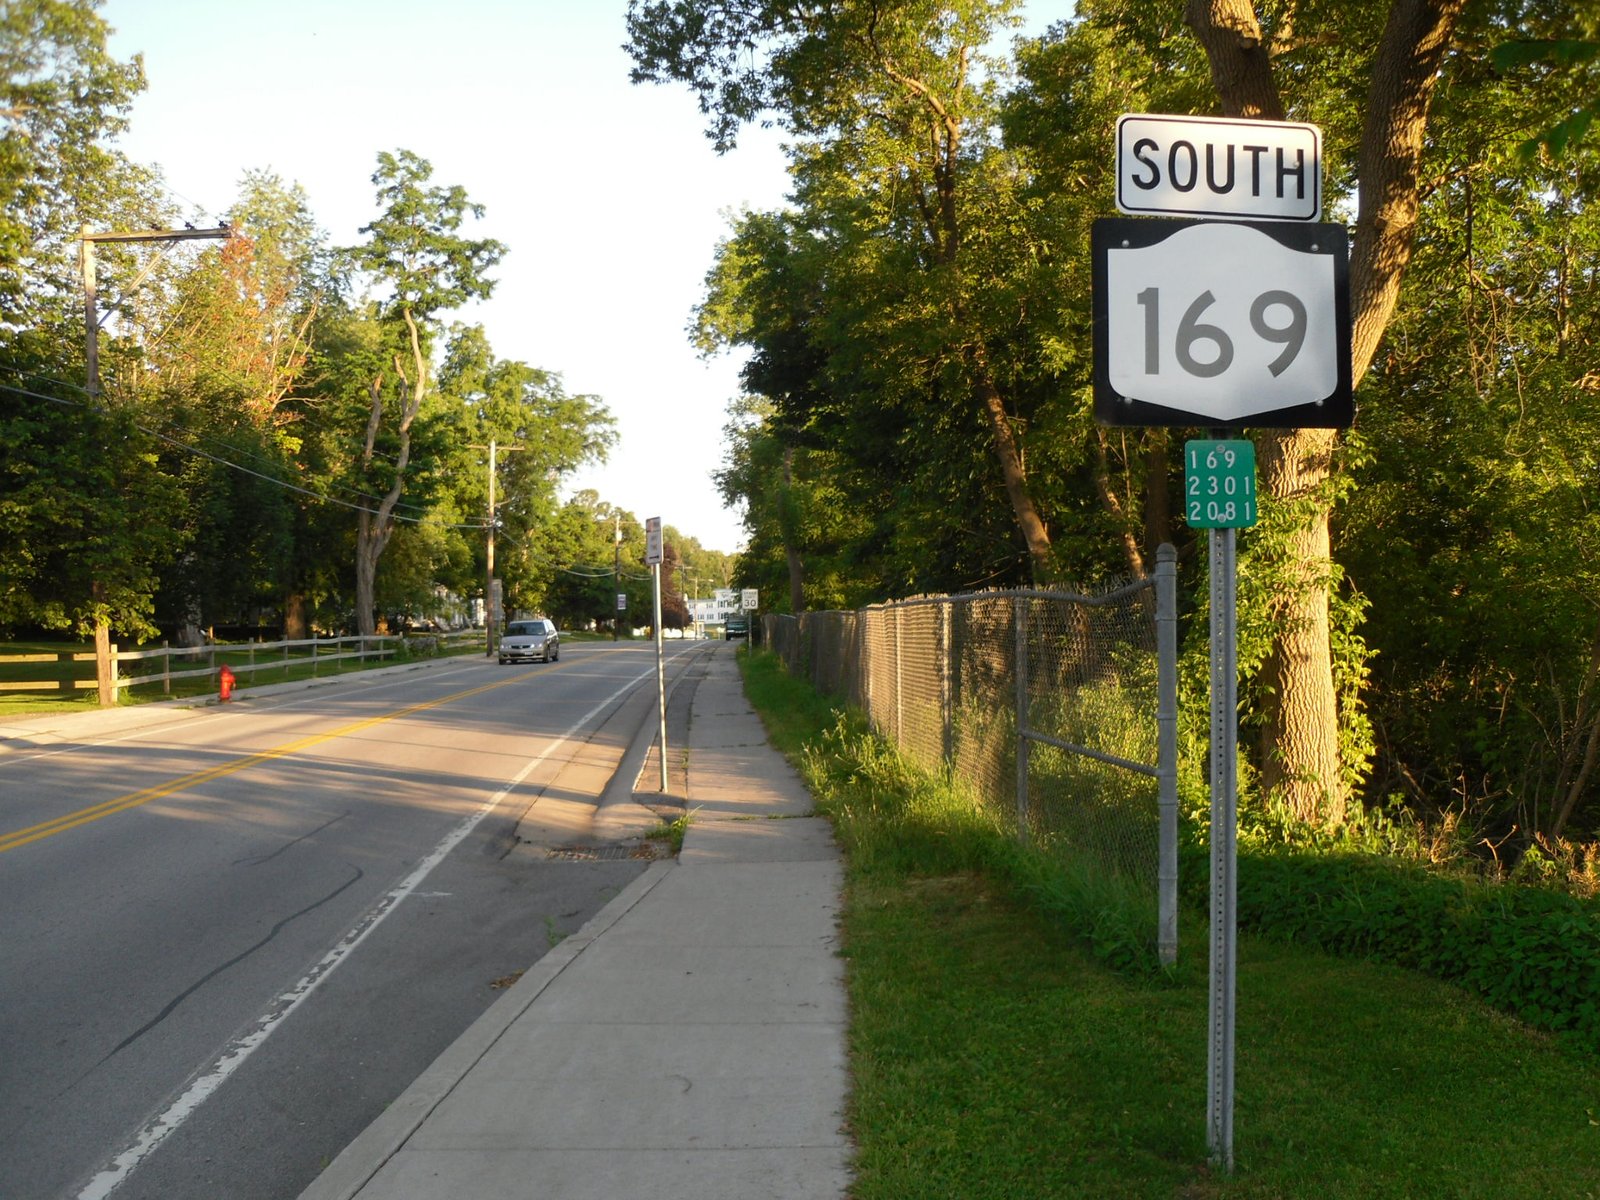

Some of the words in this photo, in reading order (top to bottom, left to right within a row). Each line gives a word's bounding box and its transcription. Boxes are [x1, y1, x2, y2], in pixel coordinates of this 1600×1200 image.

[1131, 138, 1304, 200] SOUTH
[1137, 287, 1307, 378] 169
[1191, 450, 1235, 469] 169
[1189, 476, 1250, 495] 2301
[1190, 501, 1250, 521] 2081
